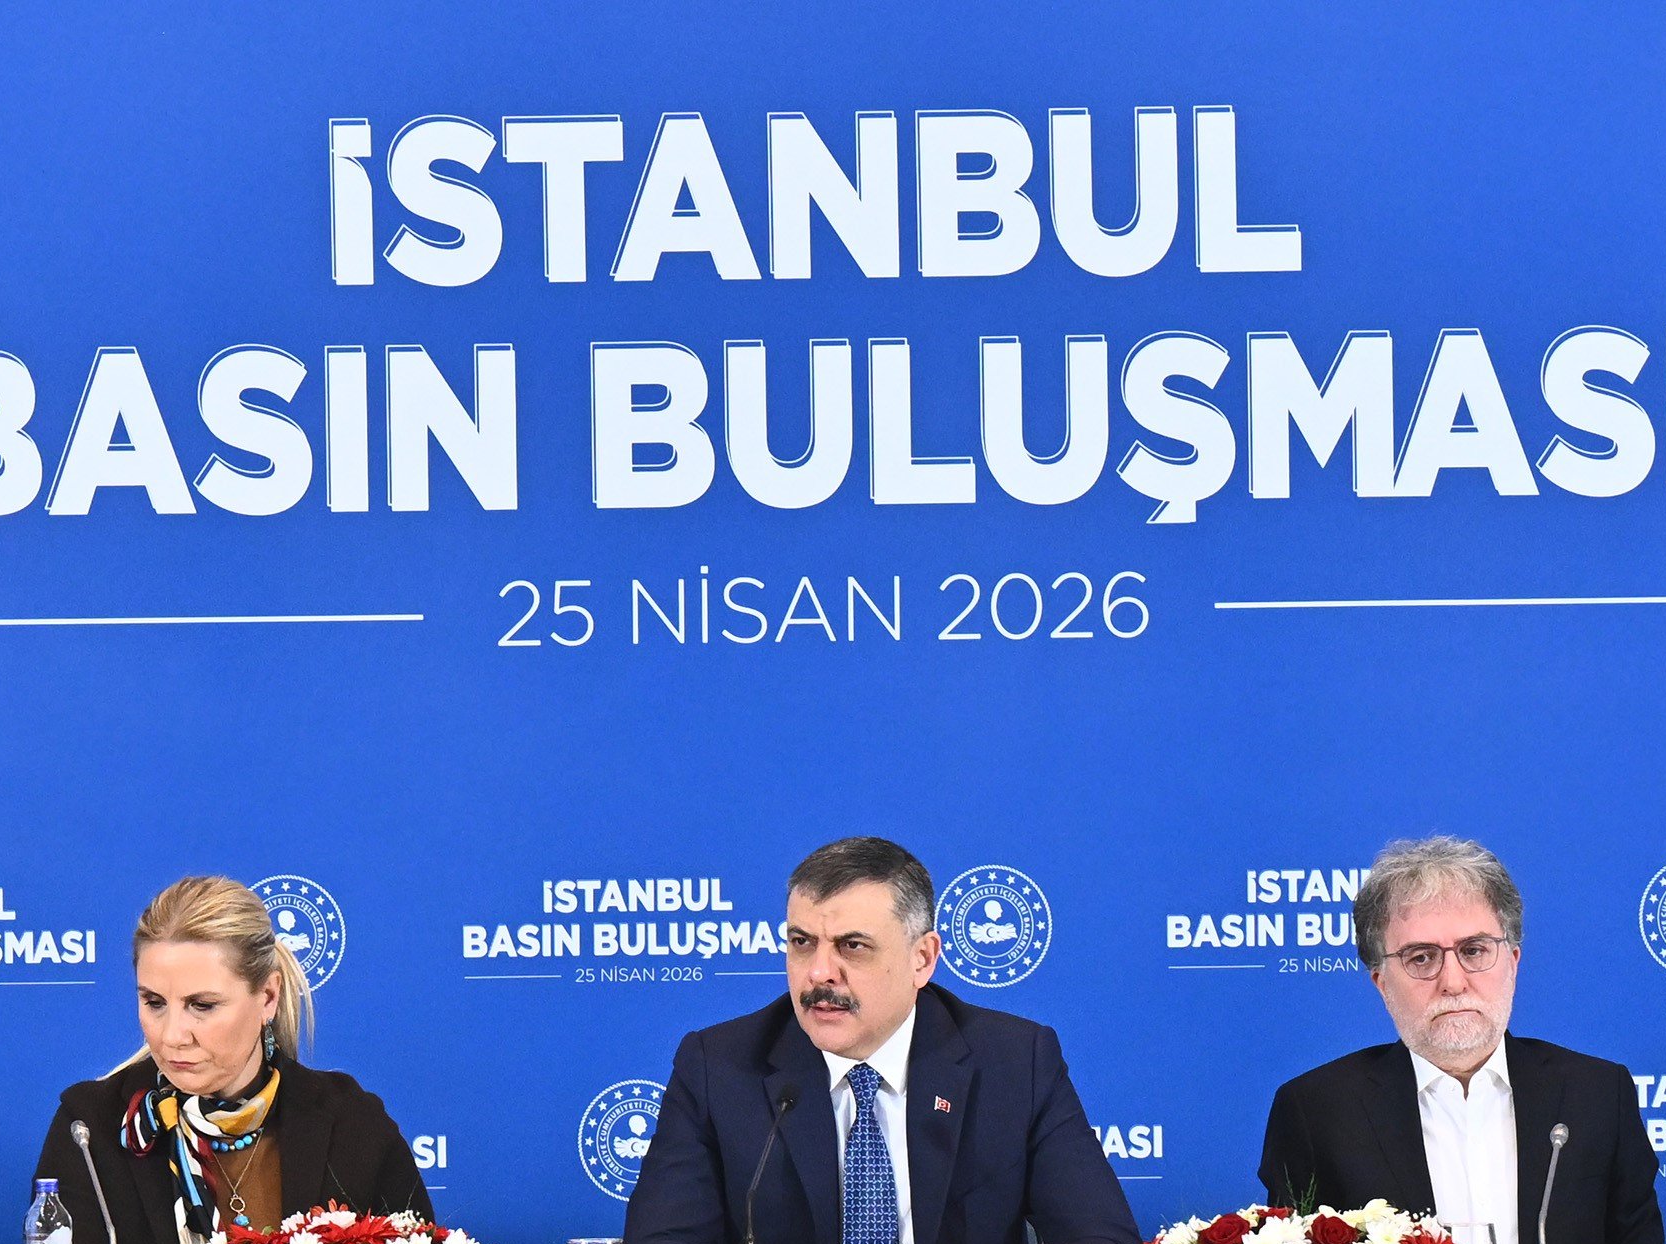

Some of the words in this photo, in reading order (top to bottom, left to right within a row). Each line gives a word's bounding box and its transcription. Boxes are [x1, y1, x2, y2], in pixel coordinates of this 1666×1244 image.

[329, 105, 1302, 287] İSTANBUL
[497, 579, 595, 647] 25
[632, 565, 901, 645] NİSAN
[938, 571, 1150, 641] 2026
[543, 878, 733, 914] İSTANBUL
[1247, 869, 1371, 904] İSTAN
[462, 924, 581, 958] BASIN
[593, 920, 788, 959] BULUŞMA
[1166, 914, 1284, 948] BASIN
[575, 968, 596, 983] 25
[601, 965, 655, 982] NİSAN
[661, 966, 703, 982] 2026
[1278, 958, 1299, 973] 25
[1304, 956, 1359, 972] NİSAN
